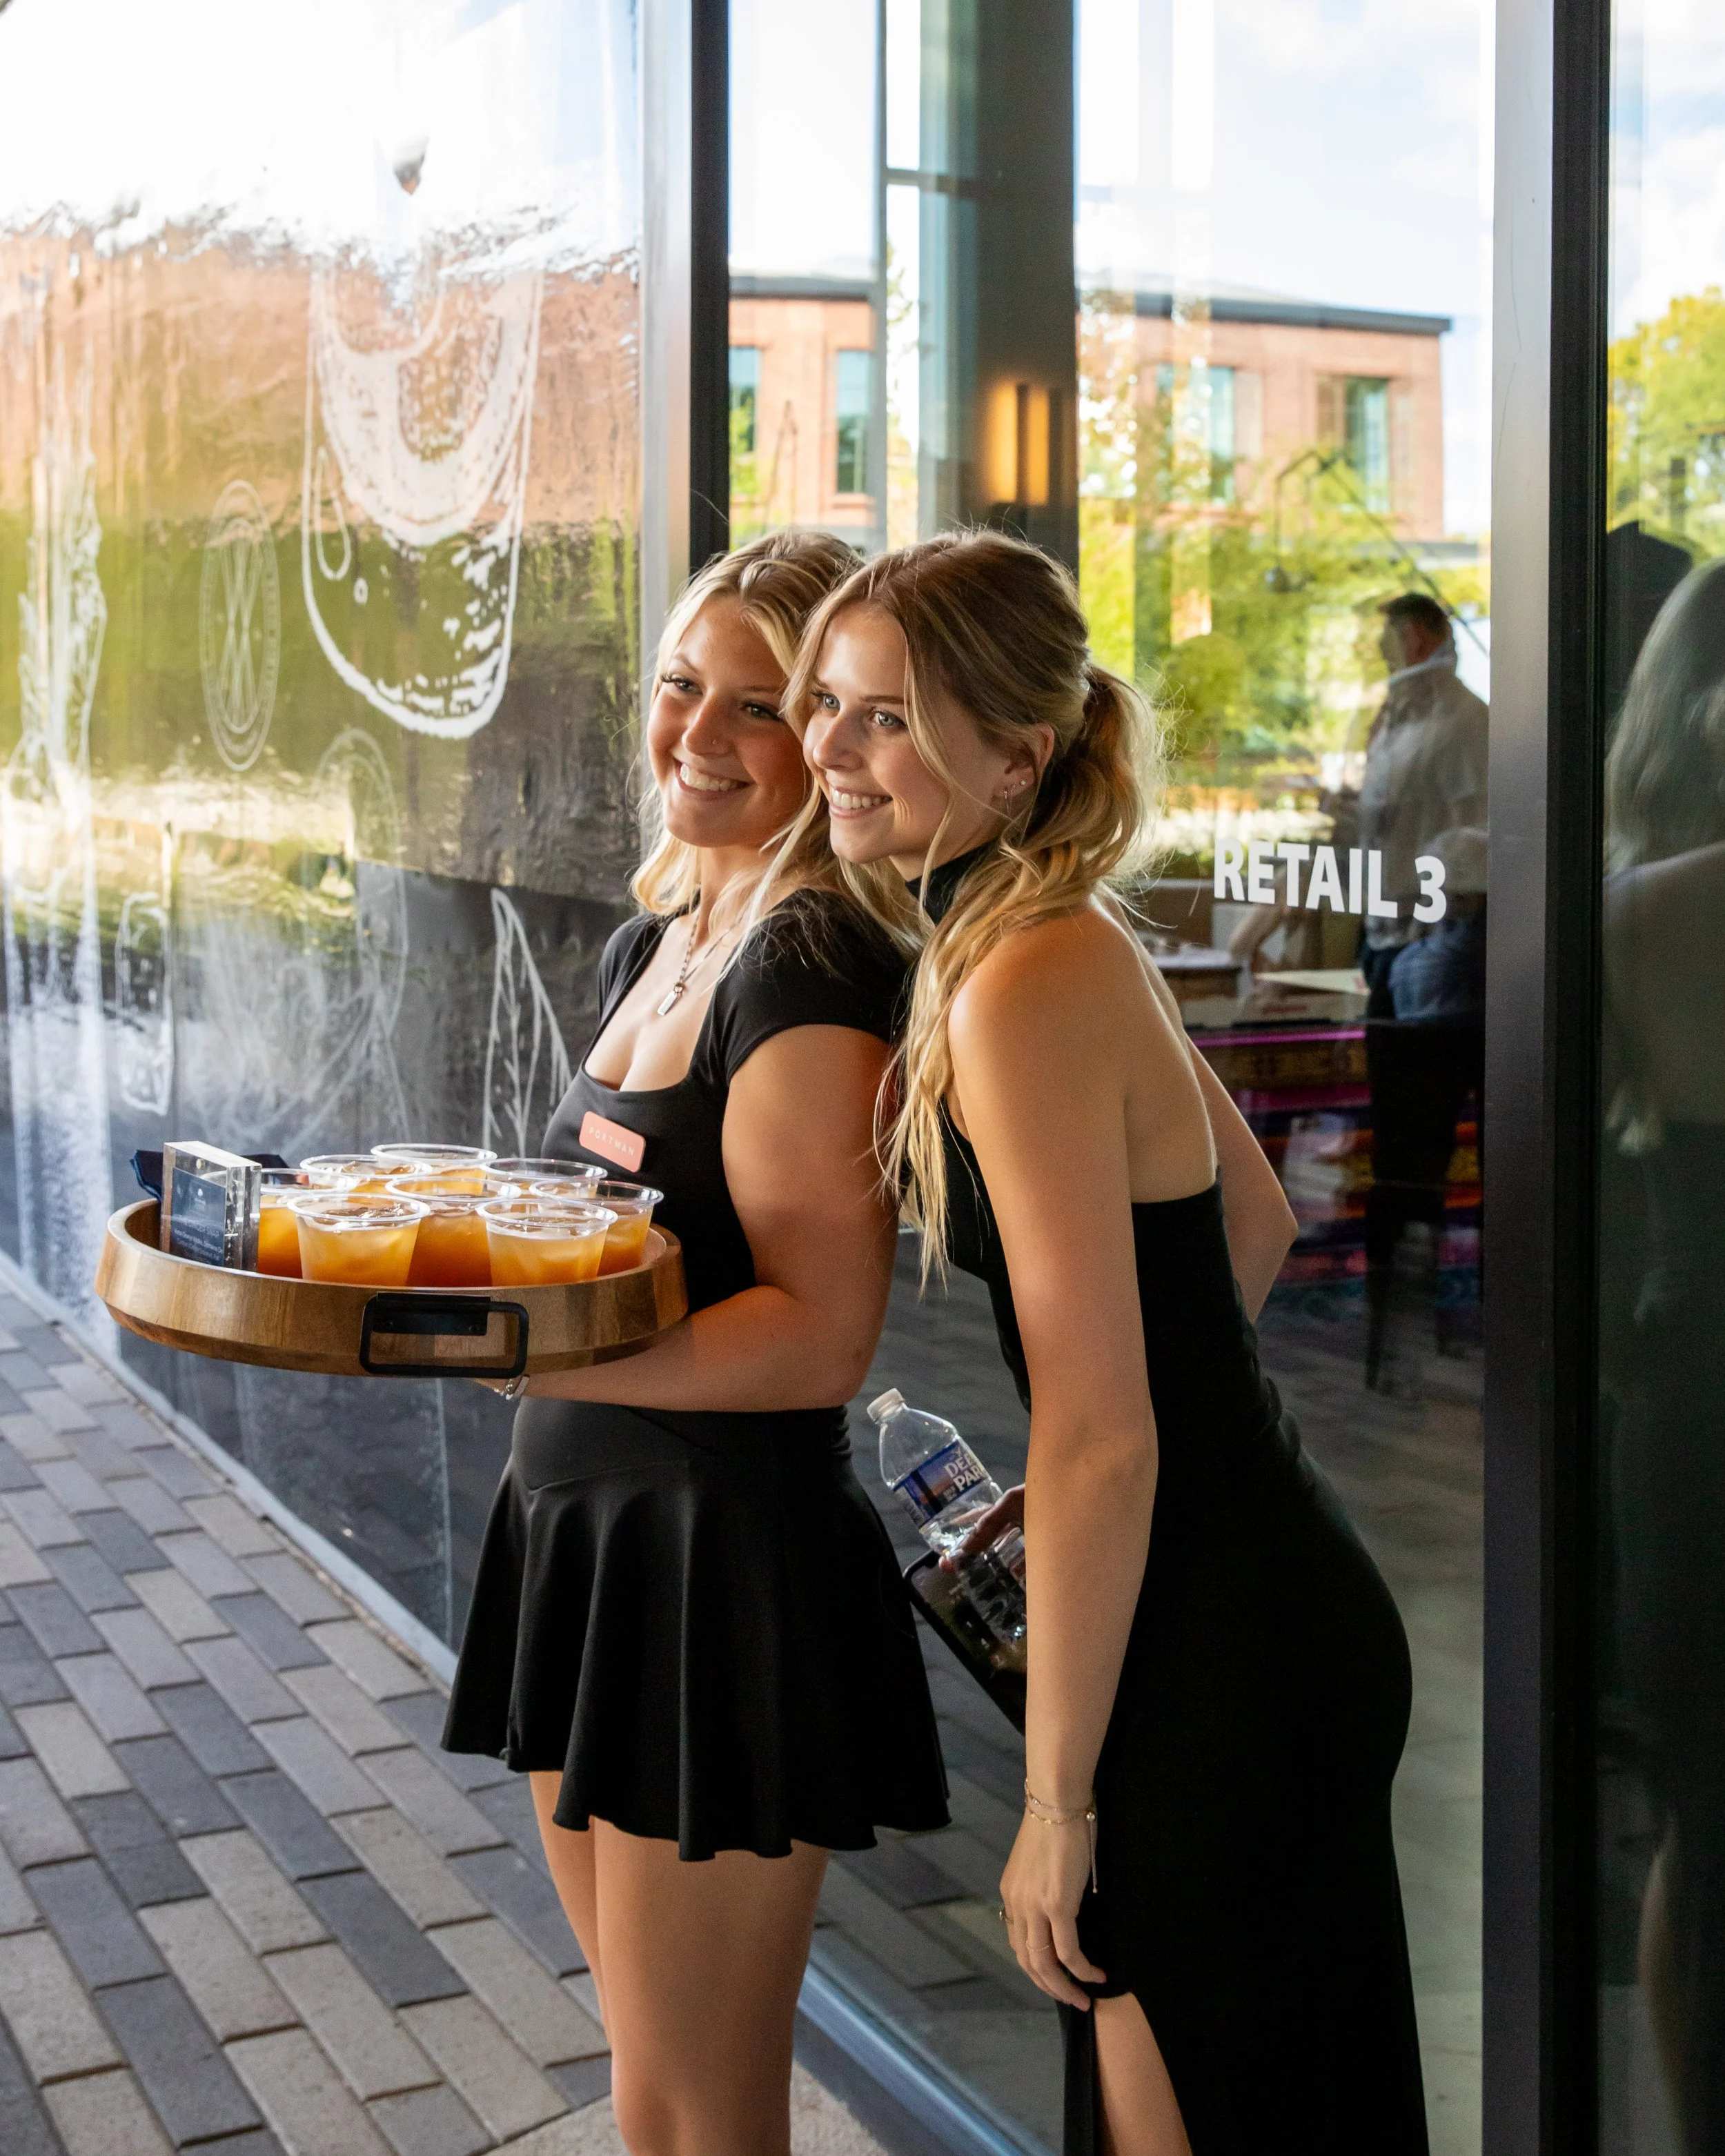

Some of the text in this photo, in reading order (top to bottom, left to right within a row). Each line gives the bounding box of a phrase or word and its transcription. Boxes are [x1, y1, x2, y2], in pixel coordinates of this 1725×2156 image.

[1213, 838, 1448, 924] RETAIL 3
[589, 1126, 635, 1156] PORTMAN
[953, 1464, 985, 1492] PAR
